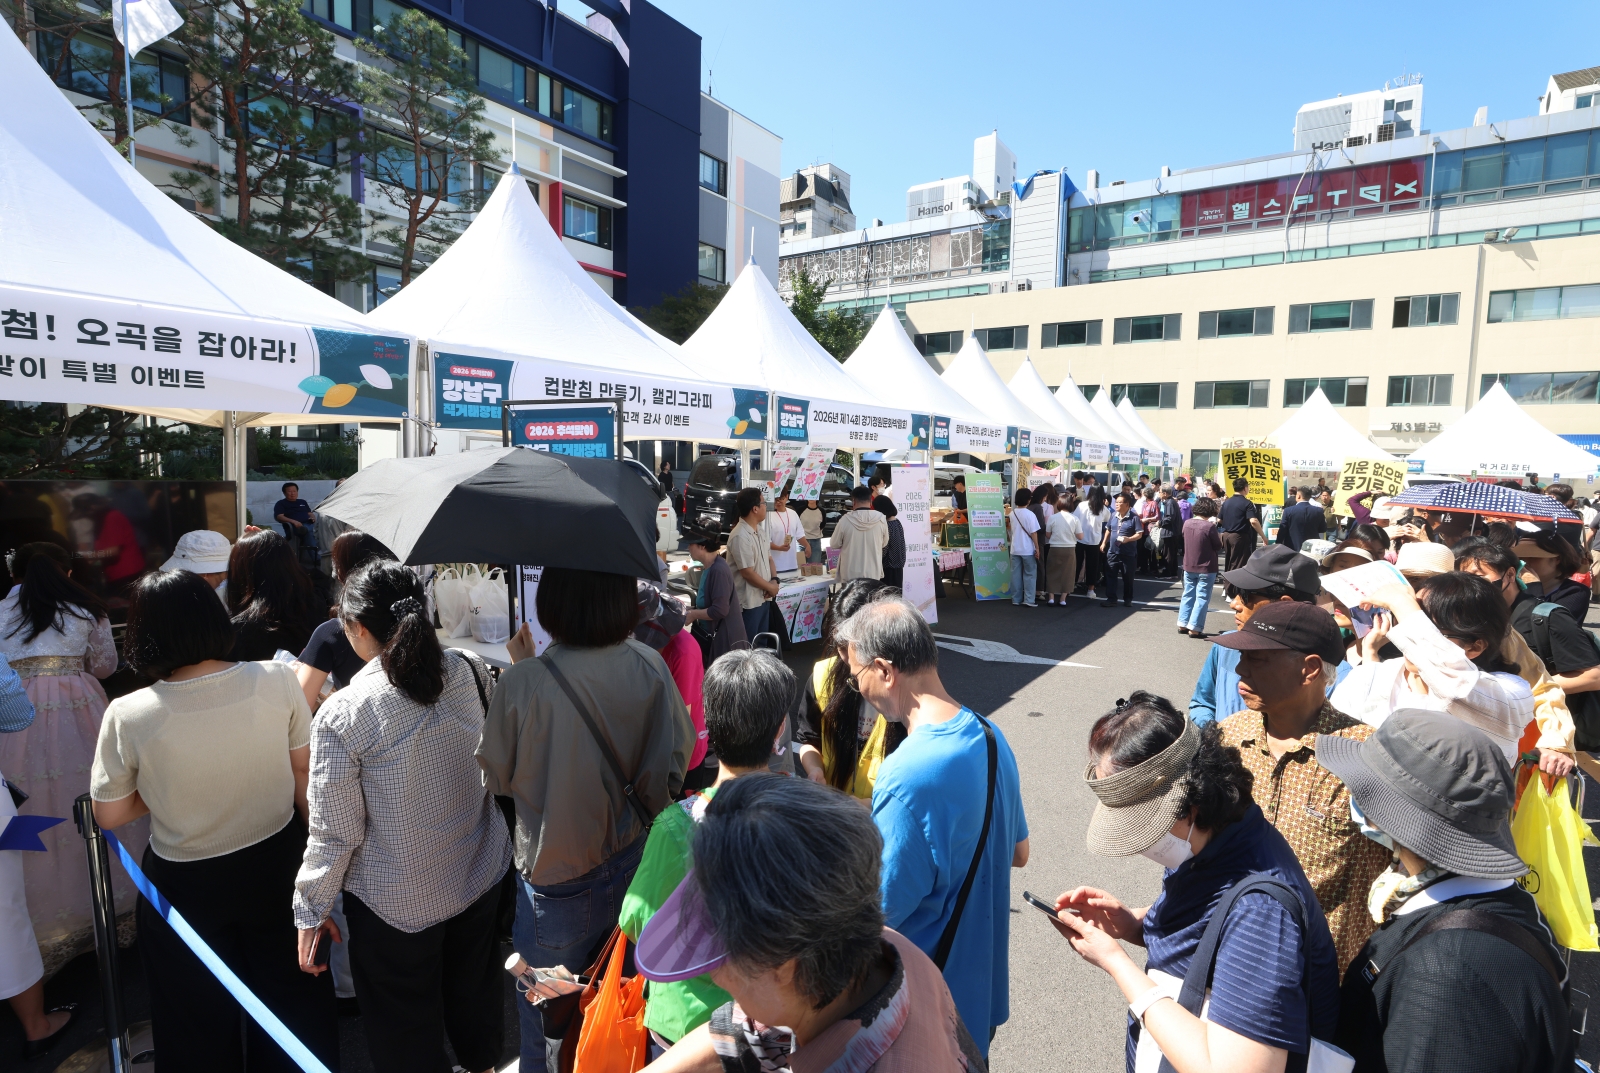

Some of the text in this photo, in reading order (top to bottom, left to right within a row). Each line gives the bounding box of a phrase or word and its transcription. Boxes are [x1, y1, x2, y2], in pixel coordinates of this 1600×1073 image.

[918, 201, 953, 216] Hansol
[1199, 213, 1225, 222] FIRST
[1, 308, 296, 363] 첨! 오곡을 잡아라!
[62, 359, 117, 384] 특별
[131, 366, 206, 389] 이벤트
[453, 367, 469, 375] 2026
[442, 379, 502, 404] 강남구
[544, 376, 712, 409] 컵받침 만들기, 캘리그라피
[443, 403, 502, 419] 직거래장터
[813, 410, 839, 424] 2026년
[840, 412, 860, 425] 제14회
[643, 413, 661, 425] 감사
[664, 414, 690, 426] 이벤트
[780, 412, 805, 428] 강남구
[529, 424, 594, 436] 2026 추석맞이
[1390, 422, 1442, 433] 제3별관
[1224, 451, 1281, 469] 기운 없으면
[1479, 463, 1531, 471] 먹거리장터
[1227, 465, 1280, 483] 풍기로 와
[1343, 460, 1404, 484] 기운 없으면
[1341, 476, 1399, 497] 풍기로 와
[905, 491, 922, 500] 2026
[1440, 512, 1452, 523] LA
